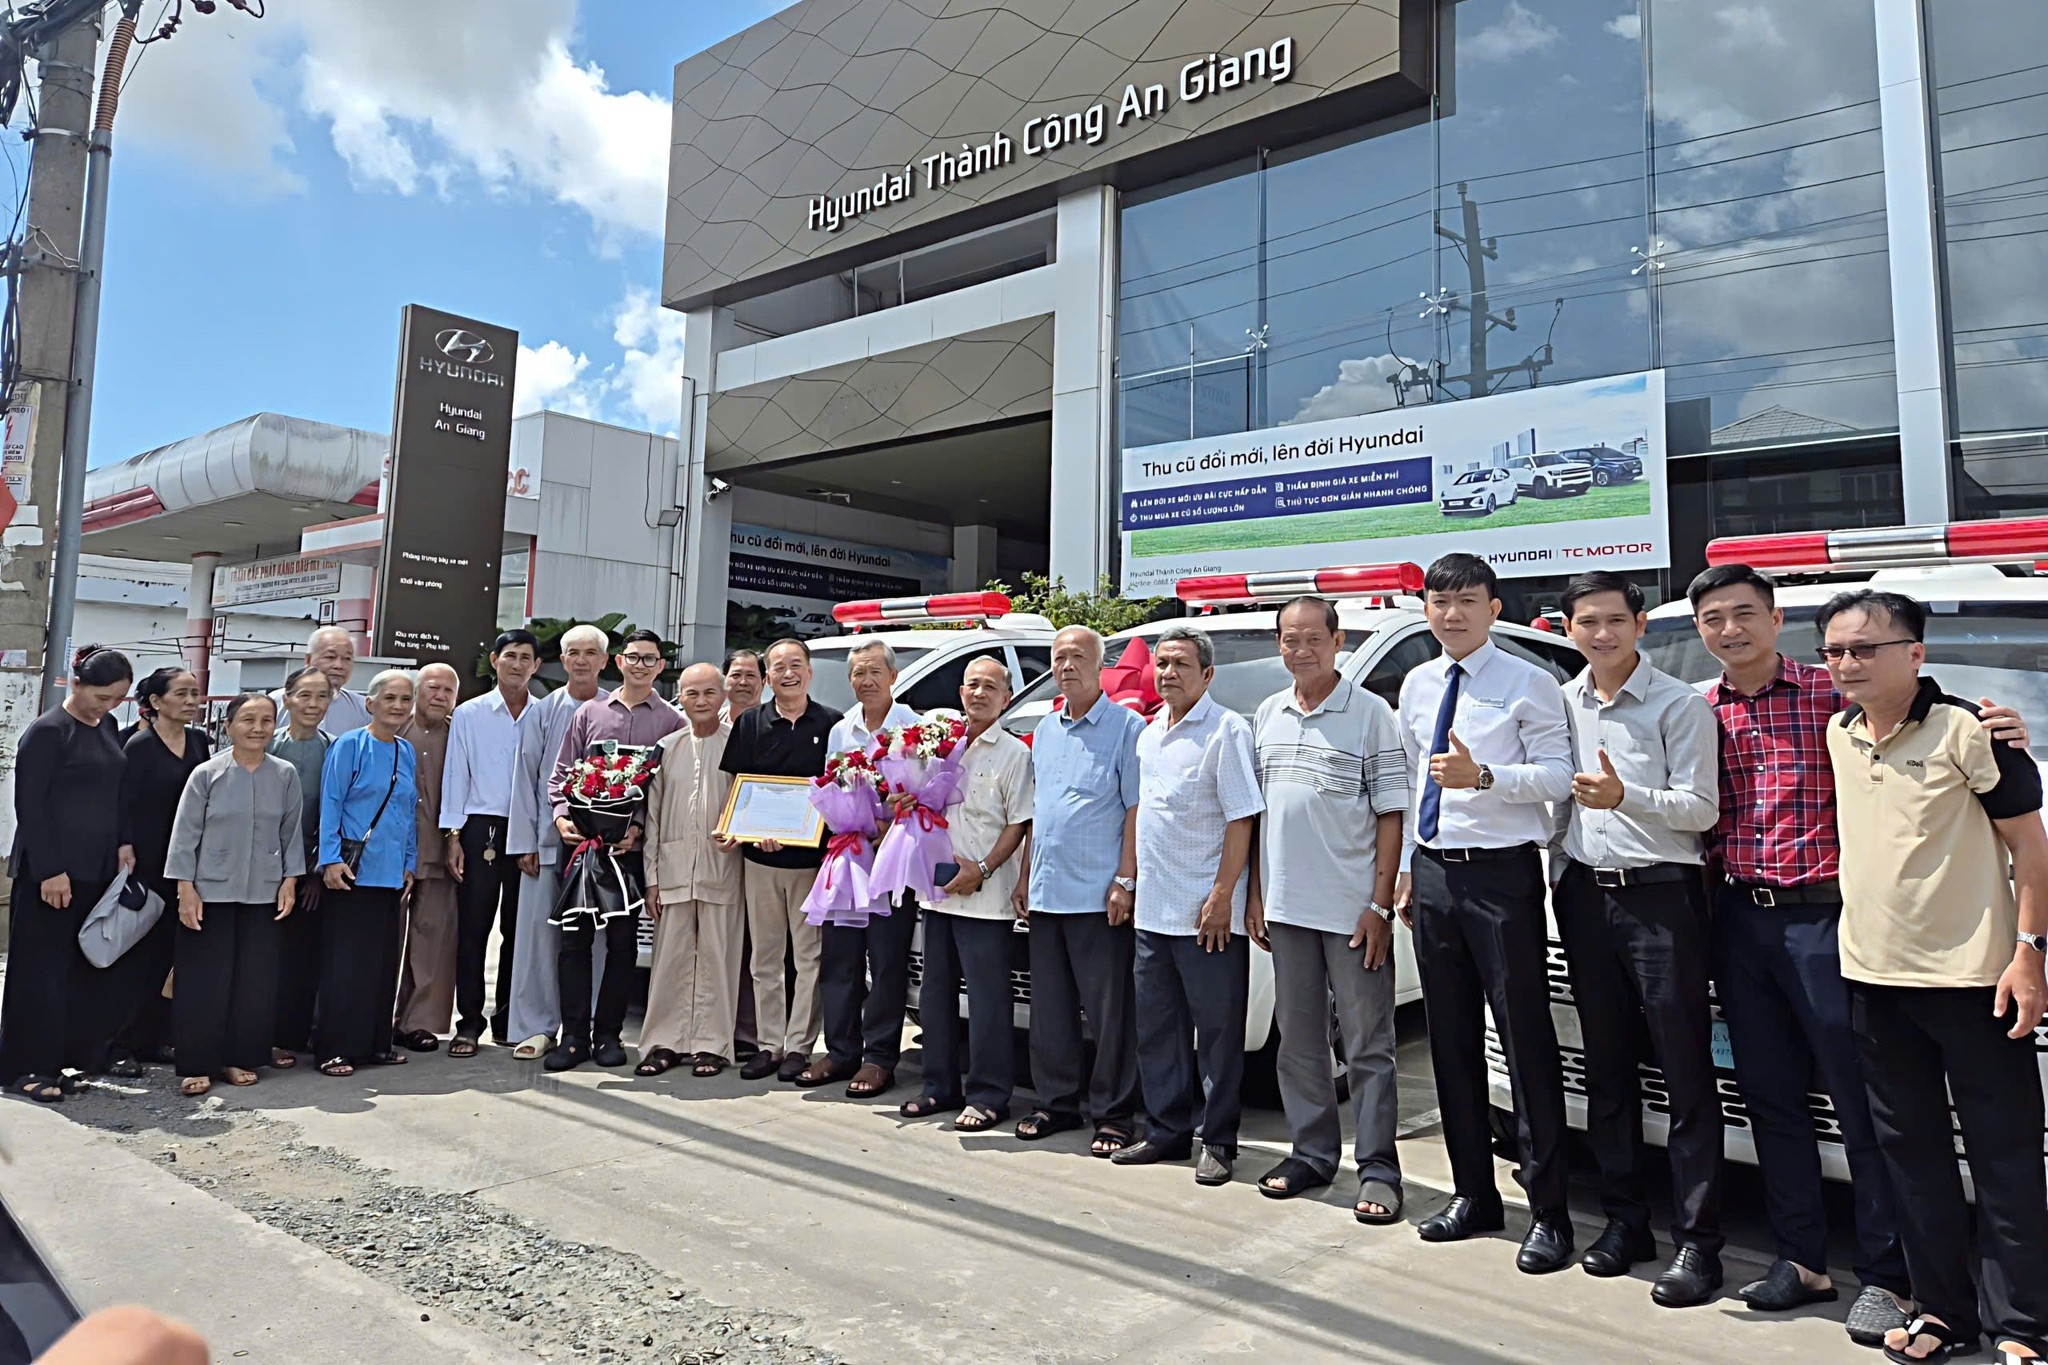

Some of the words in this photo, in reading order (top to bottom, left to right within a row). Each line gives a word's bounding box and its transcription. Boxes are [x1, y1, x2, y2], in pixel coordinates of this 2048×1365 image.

[808, 164, 912, 231] Hyundai
[922, 132, 1011, 189] Thành
[1023, 104, 1104, 155] Công
[1117, 84, 1164, 125] An
[1180, 37, 1292, 101] Giang
[420, 356, 504, 387] HYUNDAI
[440, 402, 482, 420] Hyundai
[434, 419, 450, 431] An
[455, 423, 486, 440] Giang
[1142, 462, 1172, 478] Thu
[1176, 456, 1195, 472] cũ
[1200, 449, 1225, 469] đổi
[1231, 446, 1268, 467] mới,
[1273, 443, 1299, 461] lên
[1305, 438, 1334, 457] đời
[1339, 425, 1424, 454] Hyundai
[1349, 476, 1358, 484] XE
[1384, 470, 1399, 480] PHÍ
[1304, 497, 1319, 506] TỤC
[1363, 489, 1394, 499] NHANH
[1396, 485, 1428, 496] CHÓNG
[1140, 513, 1153, 521] THU
[1155, 511, 1170, 520] MUA
[730, 532, 745, 544] hu
[747, 534, 761, 546] cũ
[764, 535, 782, 550] đổi
[785, 541, 809, 556] mới,
[811, 543, 827, 558] lên
[829, 547, 846, 561] đời
[848, 550, 891, 567] Hyundai
[1488, 549, 1552, 564] HYUNDAI
[1561, 547, 1583, 558] TC
[1587, 543, 1653, 557] MOTOR
